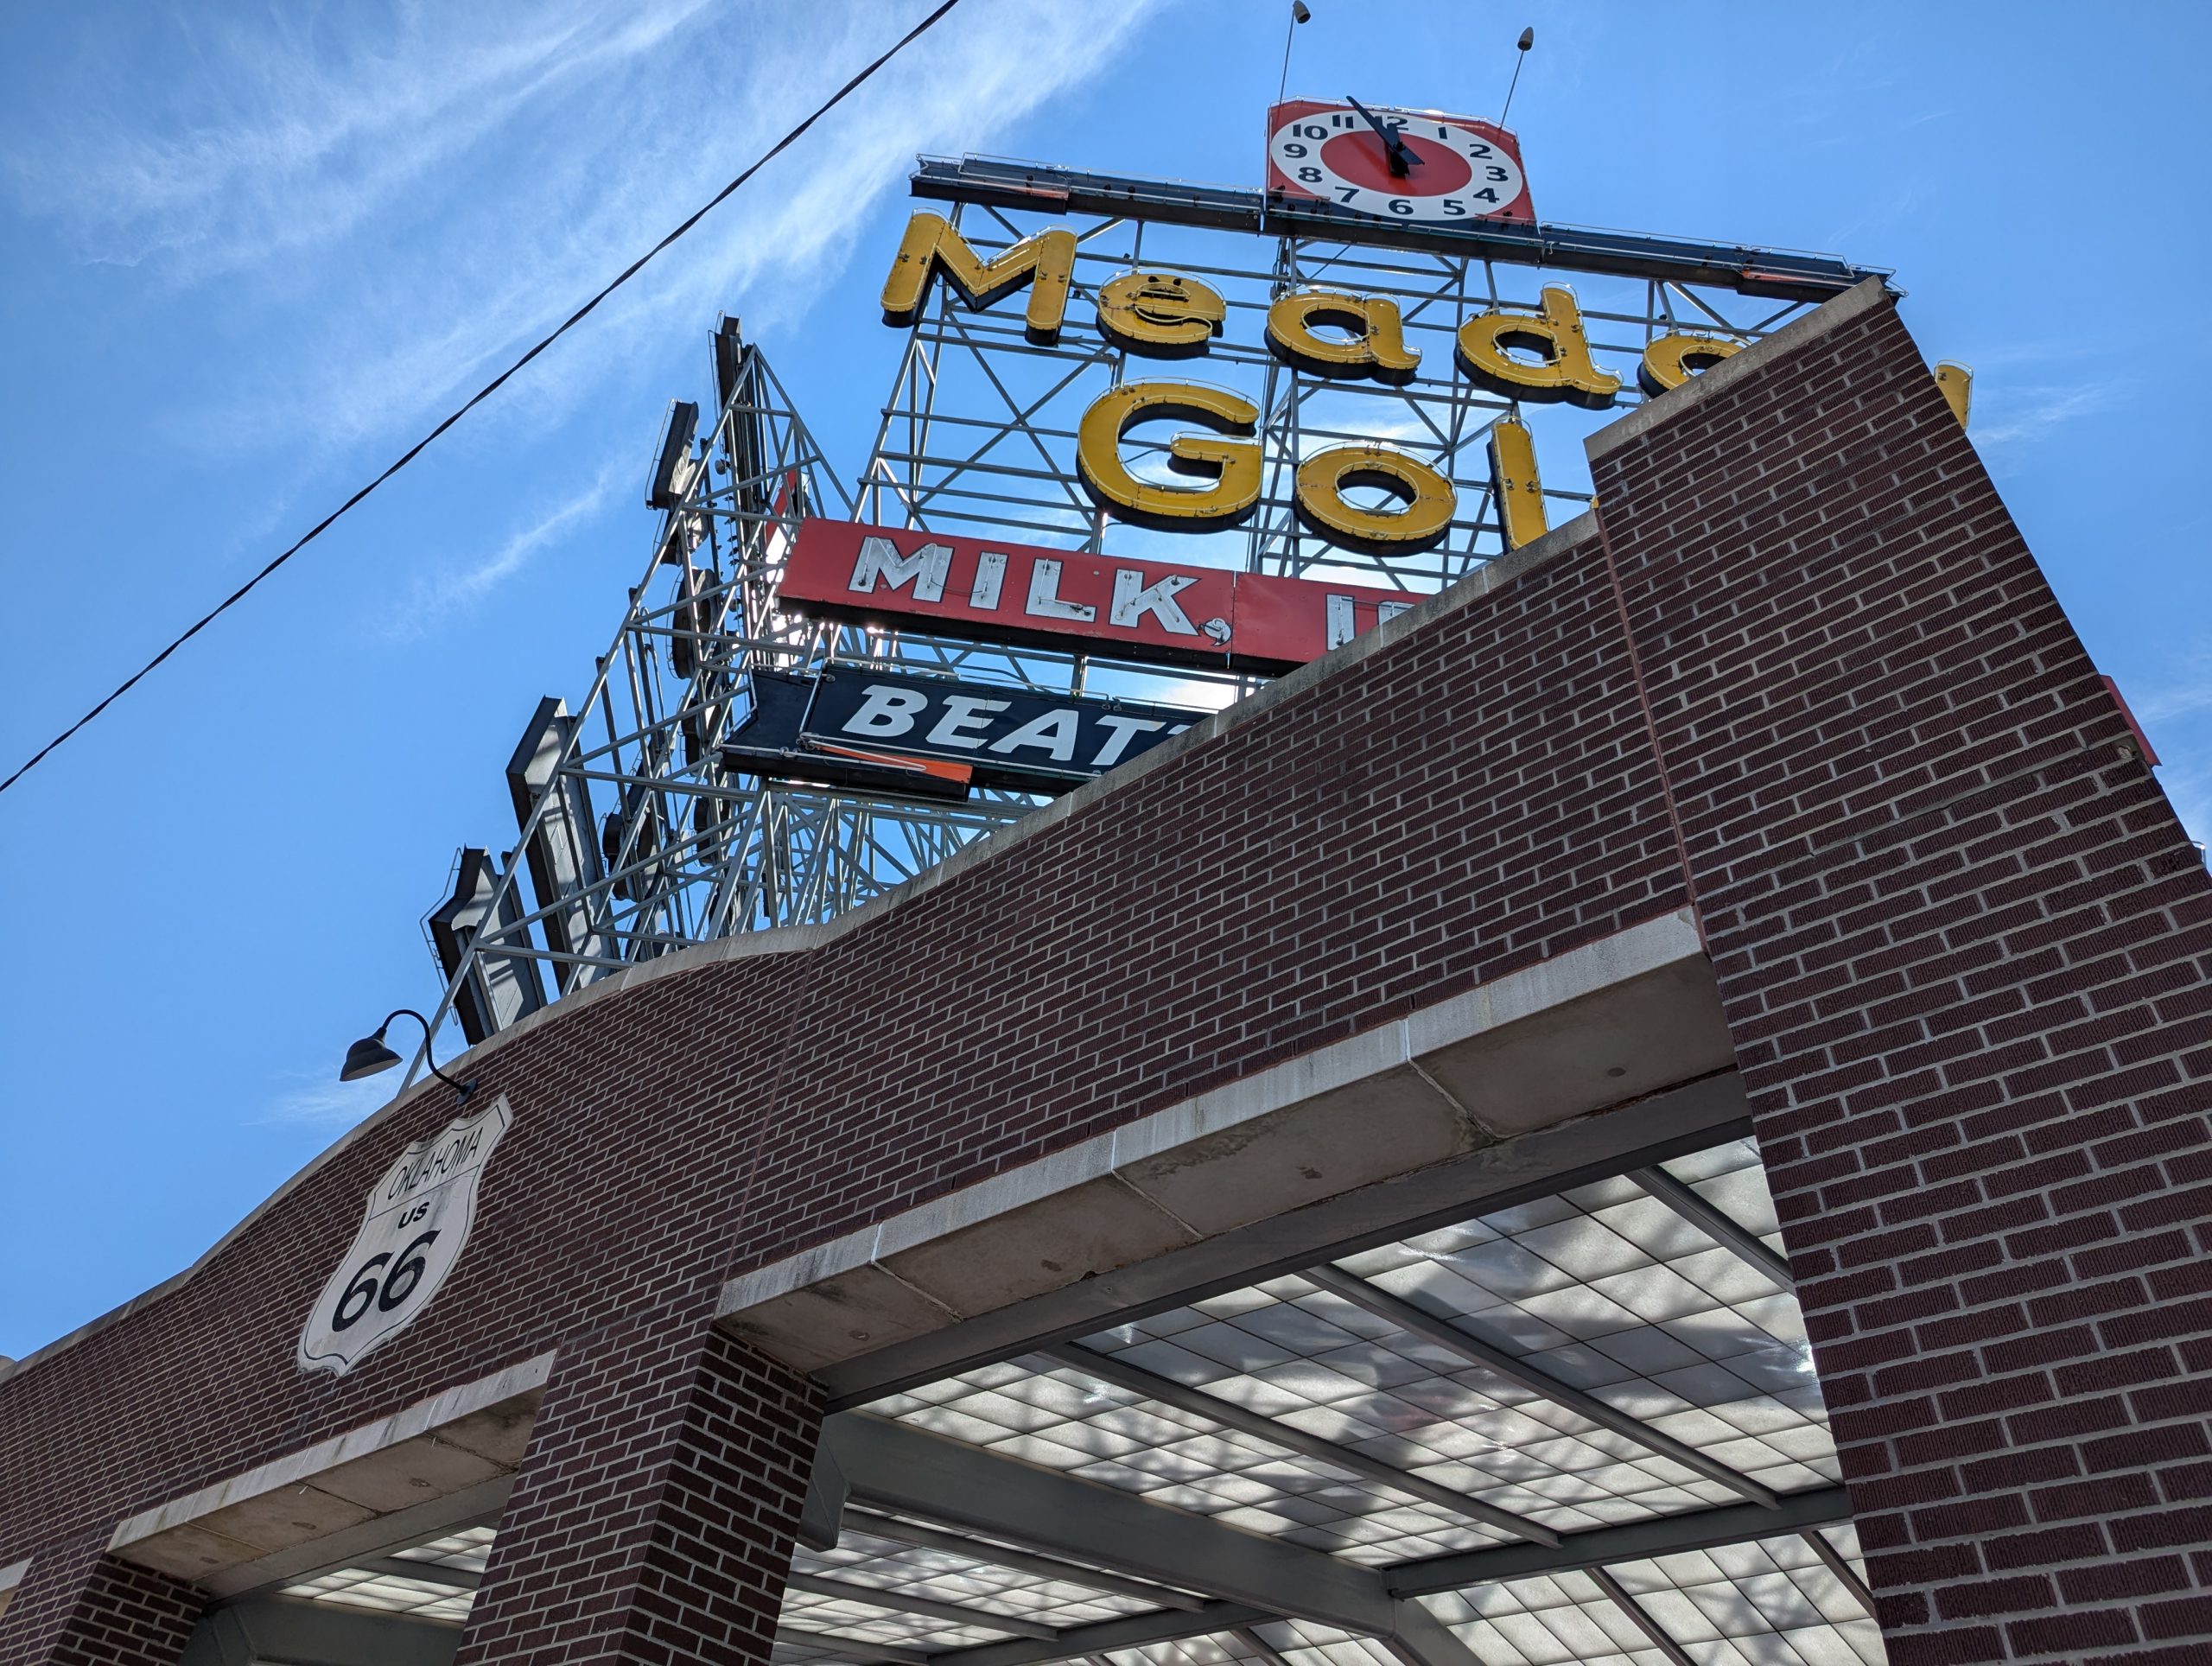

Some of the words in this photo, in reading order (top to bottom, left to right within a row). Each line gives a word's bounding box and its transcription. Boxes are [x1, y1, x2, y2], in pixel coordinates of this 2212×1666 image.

[1332, 114, 1354, 129] 11
[1292, 124, 1329, 140] 10
[1437, 126, 1448, 140] 1
[1283, 143, 1308, 159] 9
[1469, 143, 1493, 160] 2
[1298, 166, 1323, 183] 8
[1485, 165, 1509, 181] 3
[1334, 186, 1359, 203] 7
[1472, 187, 1500, 203] 4
[1388, 199, 1414, 215] 6
[1442, 199, 1466, 215] 5
[880, 210, 1974, 429] Meado
[1077, 378, 1599, 556] Gol
[841, 684, 1192, 766] BEAT
[387, 1126, 484, 1200] OKLAHOMA
[397, 1201, 430, 1229] US
[331, 1229, 442, 1332] 66
